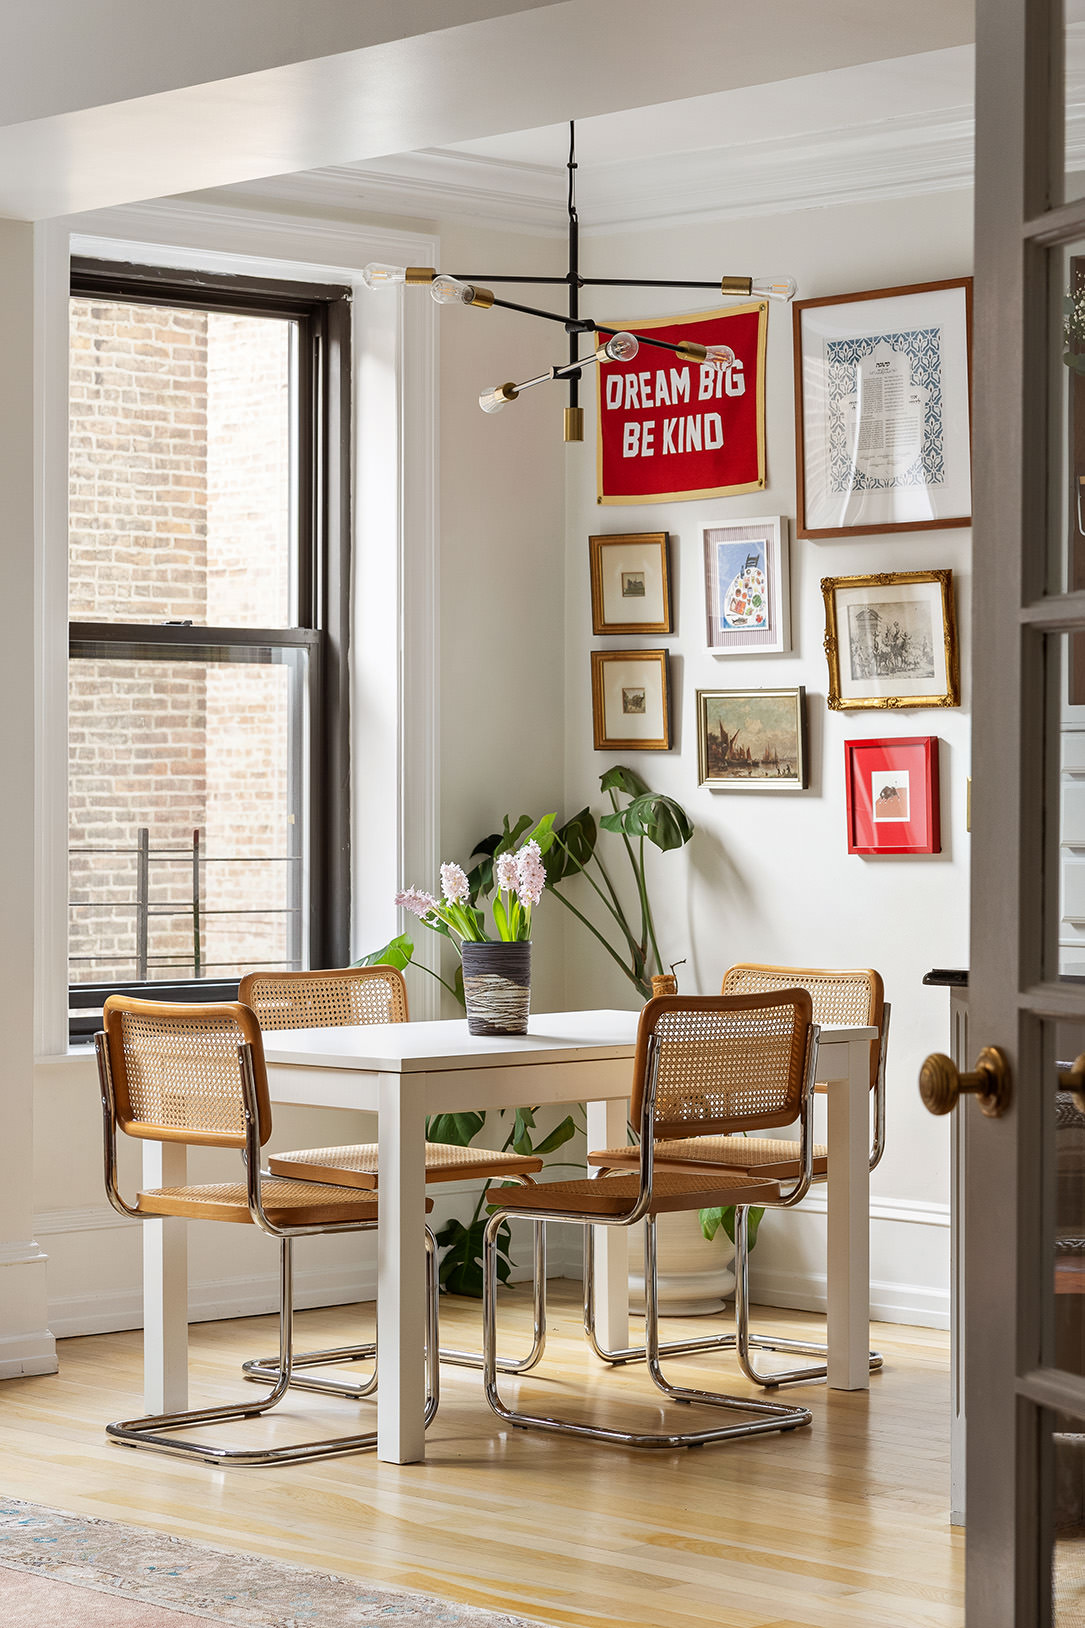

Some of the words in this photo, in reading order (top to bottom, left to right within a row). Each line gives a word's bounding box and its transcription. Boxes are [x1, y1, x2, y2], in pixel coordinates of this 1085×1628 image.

[606, 366, 690, 410] DREAM
[698, 359, 745, 400] BIG
[623, 420, 655, 458] BE
[662, 412, 724, 455] KIND
